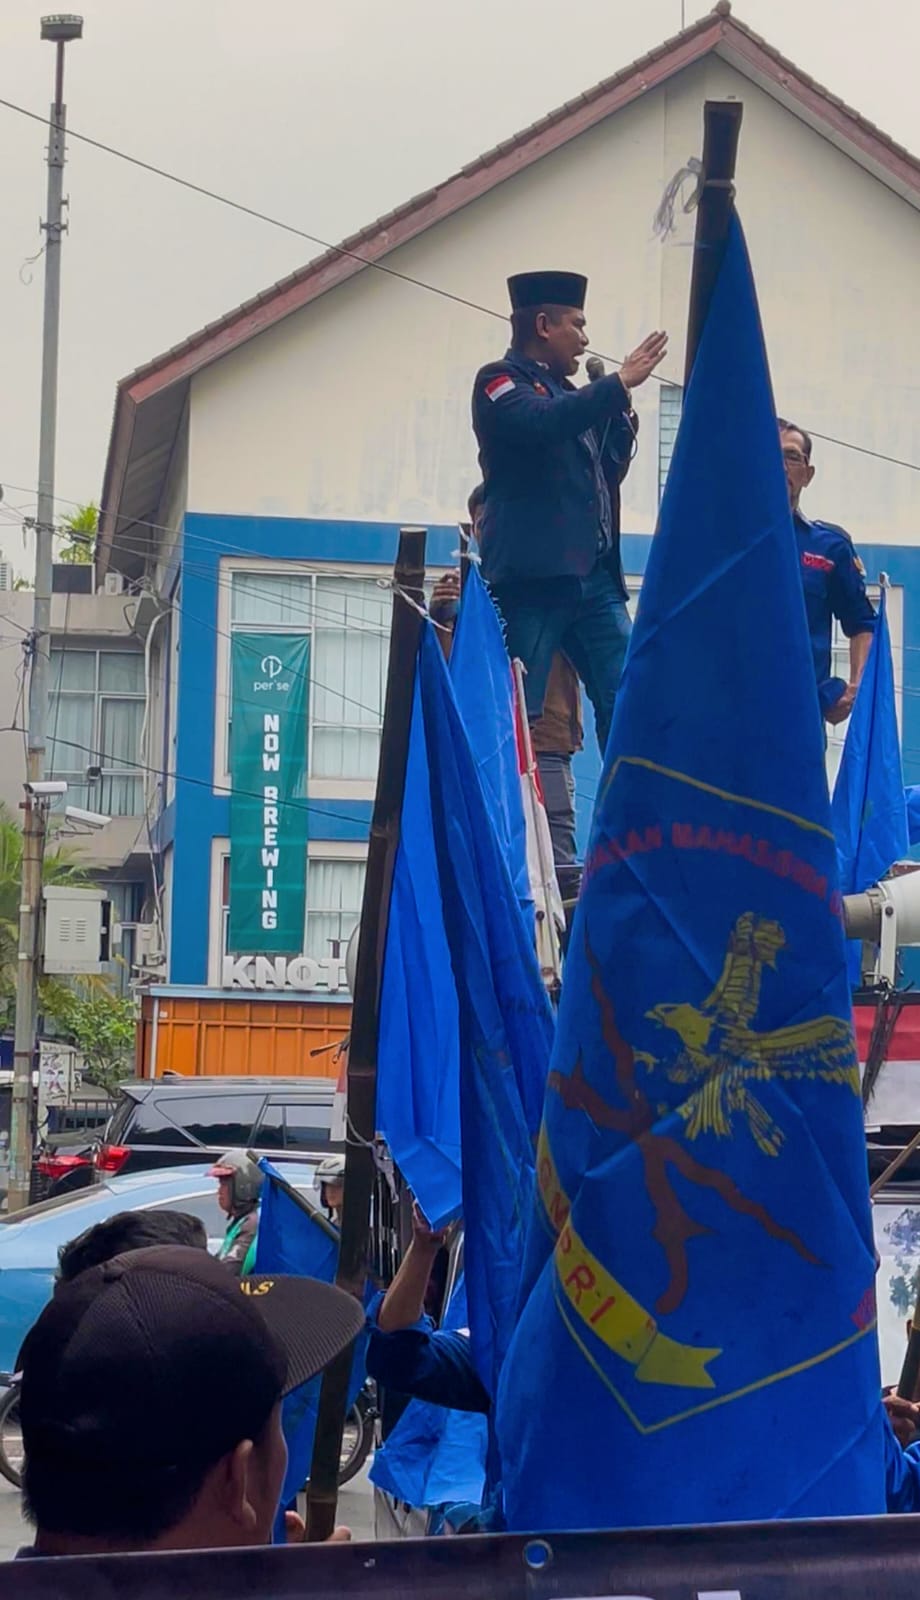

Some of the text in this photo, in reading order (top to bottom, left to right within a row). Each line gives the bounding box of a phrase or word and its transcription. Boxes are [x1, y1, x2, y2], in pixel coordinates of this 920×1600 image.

[254, 680, 289, 692] per'se
[261, 714, 280, 929] NOW BREWING
